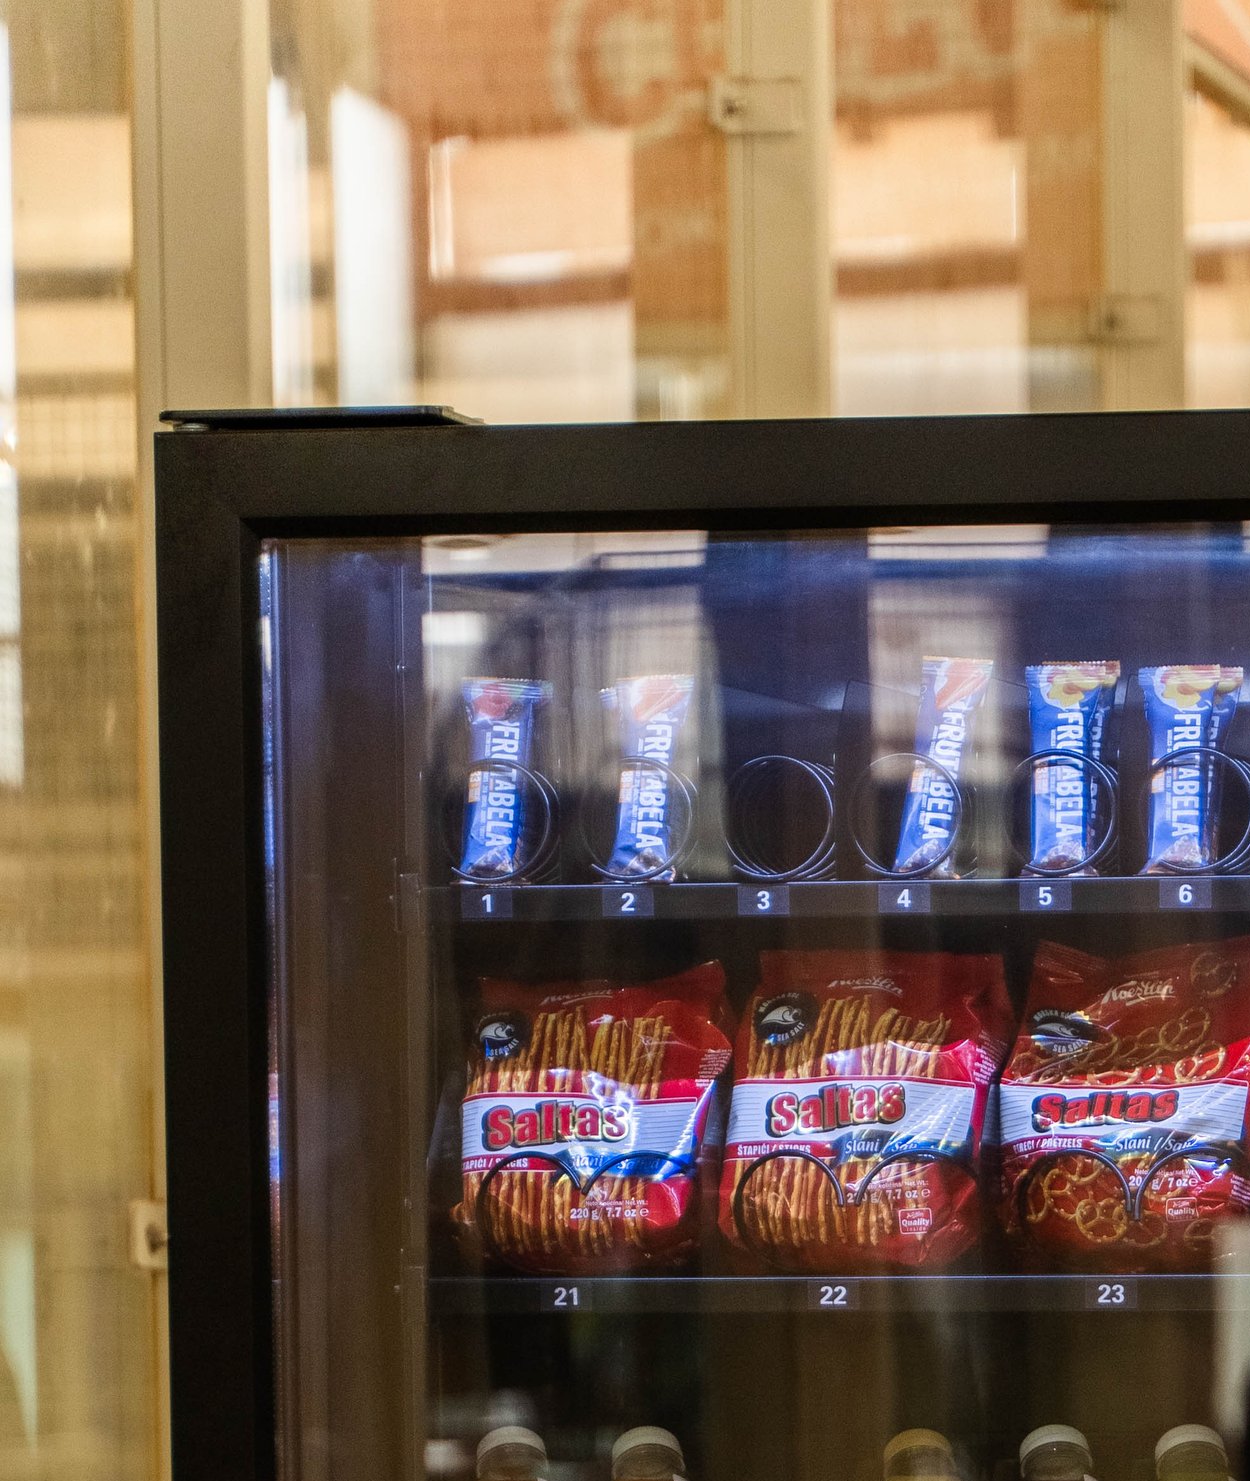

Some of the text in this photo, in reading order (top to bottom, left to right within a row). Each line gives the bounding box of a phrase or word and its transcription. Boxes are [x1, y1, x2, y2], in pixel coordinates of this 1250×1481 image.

[922, 711, 967, 840] FRUTABELA
[482, 894, 491, 912] 1
[621, 892, 634, 911] 2
[757, 891, 770, 910] 3
[897, 889, 911, 907] 4
[1039, 887, 1052, 905] 5
[1178, 884, 1192, 903] 6
[766, 1083, 906, 1138] Saltas
[1031, 1090, 1180, 1133] Saltas
[482, 1100, 632, 1151] Saltas
[886, 1189, 918, 1199] 7.7 oz
[570, 1207, 637, 1219] 220 7.7 oz
[1168, 1207, 1196, 1216] Quality
[902, 1217, 930, 1227] Quality
[554, 1287, 578, 1306] 21
[820, 1286, 847, 1305] 22
[1098, 1284, 1124, 1303] 23
